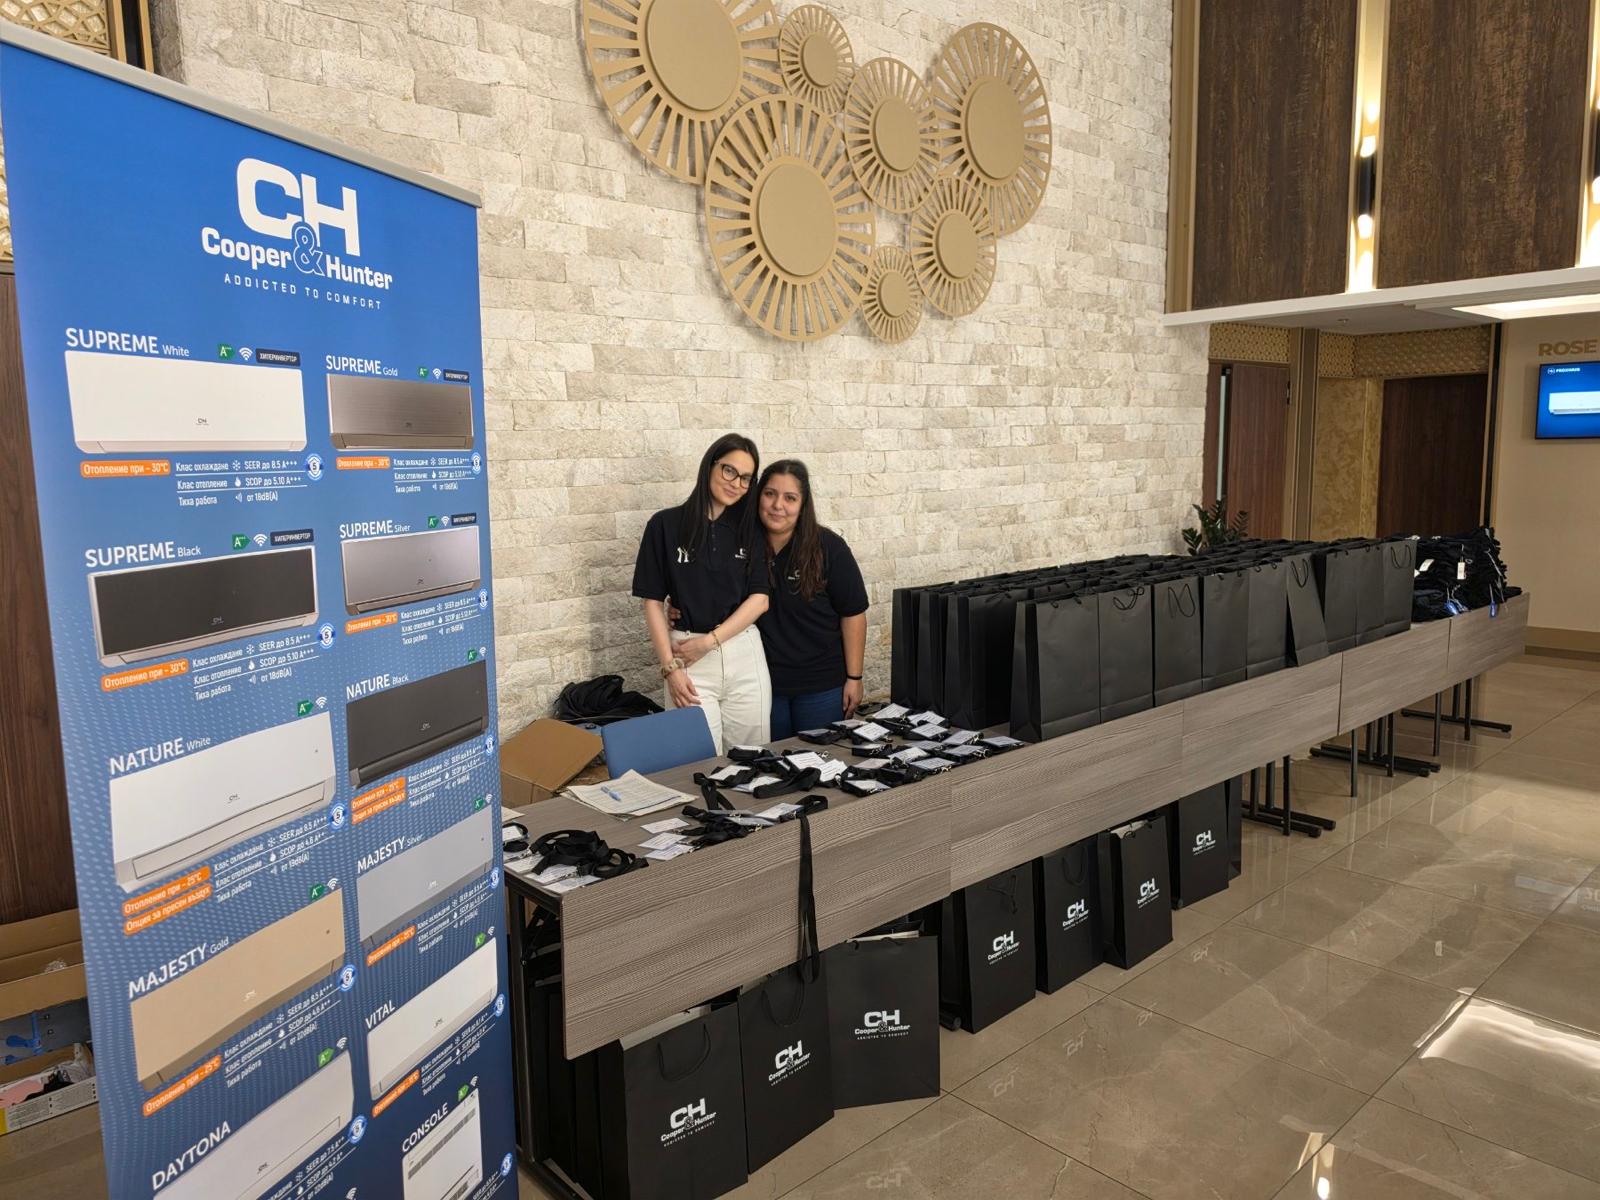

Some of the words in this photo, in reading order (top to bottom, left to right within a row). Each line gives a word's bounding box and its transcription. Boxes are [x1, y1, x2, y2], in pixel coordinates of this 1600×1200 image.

[237, 158, 360, 256] CH
[202, 227, 292, 270] Cooper
[293, 226, 325, 276] &
[325, 254, 392, 289] Hunter
[224, 273, 297, 295] ADDICTED
[305, 288, 318, 298] TO
[326, 292, 381, 310] COMFORT
[66, 328, 159, 353] SUPREME
[162, 344, 189, 356] White
[1538, 340, 1597, 356] ROSE
[326, 355, 381, 374] SUPREME
[383, 367, 398, 376] Gold
[84, 465, 129, 474] Отопление
[130, 466, 144, 474] при
[152, 463, 168, 473] 30°C
[176, 462, 193, 472] Клас
[194, 462, 228, 472] охлаждане
[244, 461, 260, 470] SEER
[262, 462, 270, 470] до
[178, 480, 194, 490] Клас
[196, 479, 227, 489] отопление
[246, 477, 262, 486] SCOP
[264, 478, 272, 486] до
[179, 496, 194, 507] Тиха
[195, 496, 217, 506] работа
[247, 494, 254, 502] от
[340, 520, 393, 538] SUPREME
[85, 542, 175, 568] SUPREME
[178, 546, 201, 557] Black
[192, 657, 208, 668] Клас
[209, 649, 243, 665] охлаждане
[259, 642, 275, 651] SEER
[276, 641, 284, 649] до
[104, 674, 148, 688] Отопление
[149, 669, 163, 678] при
[170, 661, 186, 672] 30°C
[194, 675, 210, 685] Клас
[211, 666, 242, 681] отопление
[260, 657, 276, 667] SCOP
[277, 656, 286, 665] до
[195, 691, 210, 701] Тиха
[210, 684, 231, 698] работа
[261, 674, 269, 682] от
[346, 674, 390, 699] NATURE
[393, 675, 408, 685] Black
[110, 738, 184, 775] NATURE
[186, 737, 211, 751] White
[214, 860, 229, 872] Клас
[230, 844, 264, 865] охлаждане
[279, 829, 295, 842] SEER
[295, 827, 303, 837] до
[1196, 830, 1211, 845] CH
[215, 876, 230, 888] Клас
[231, 861, 262, 880] отопление
[280, 845, 296, 858] SCOP
[297, 842, 305, 852] до
[358, 836, 406, 873] MAJESTY
[407, 834, 423, 846] Silver
[125, 894, 166, 914] Отопление
[168, 884, 180, 898] при
[216, 890, 230, 903] Тиха
[231, 880, 252, 900] работа
[1140, 878, 1155, 896] CH
[126, 913, 151, 932] Опция
[150, 909, 162, 922] за
[163, 897, 187, 918] пресен
[187, 886, 210, 906] въздух
[1068, 899, 1084, 918] CH
[993, 930, 1014, 951] CH
[128, 943, 206, 999] MAJESTY
[210, 936, 229, 954] Gold
[365, 1000, 396, 1029] VITAL
[864, 1010, 900, 1027] CH
[224, 1045, 239, 1058] Клас
[240, 1022, 273, 1048] охлаждане
[287, 1003, 302, 1017] SEER
[225, 1062, 240, 1074] Клас
[241, 1038, 272, 1059] отопление
[288, 1017, 304, 1031] SCOP
[775, 1040, 802, 1069] CH
[226, 1076, 241, 1089] Тиха
[241, 1059, 262, 1081] работа
[146, 1084, 185, 1112] Отопление
[186, 1075, 199, 1088] при
[402, 1103, 449, 1152] CONSOLE
[661, 1127, 685, 1141] Cooper
[695, 1112, 716, 1126] Hunter
[670, 1098, 706, 1129] CH
[153, 1121, 231, 1191] DAYTONA
[306, 1158, 320, 1174] SEER
[306, 1170, 321, 1187] SCOP
